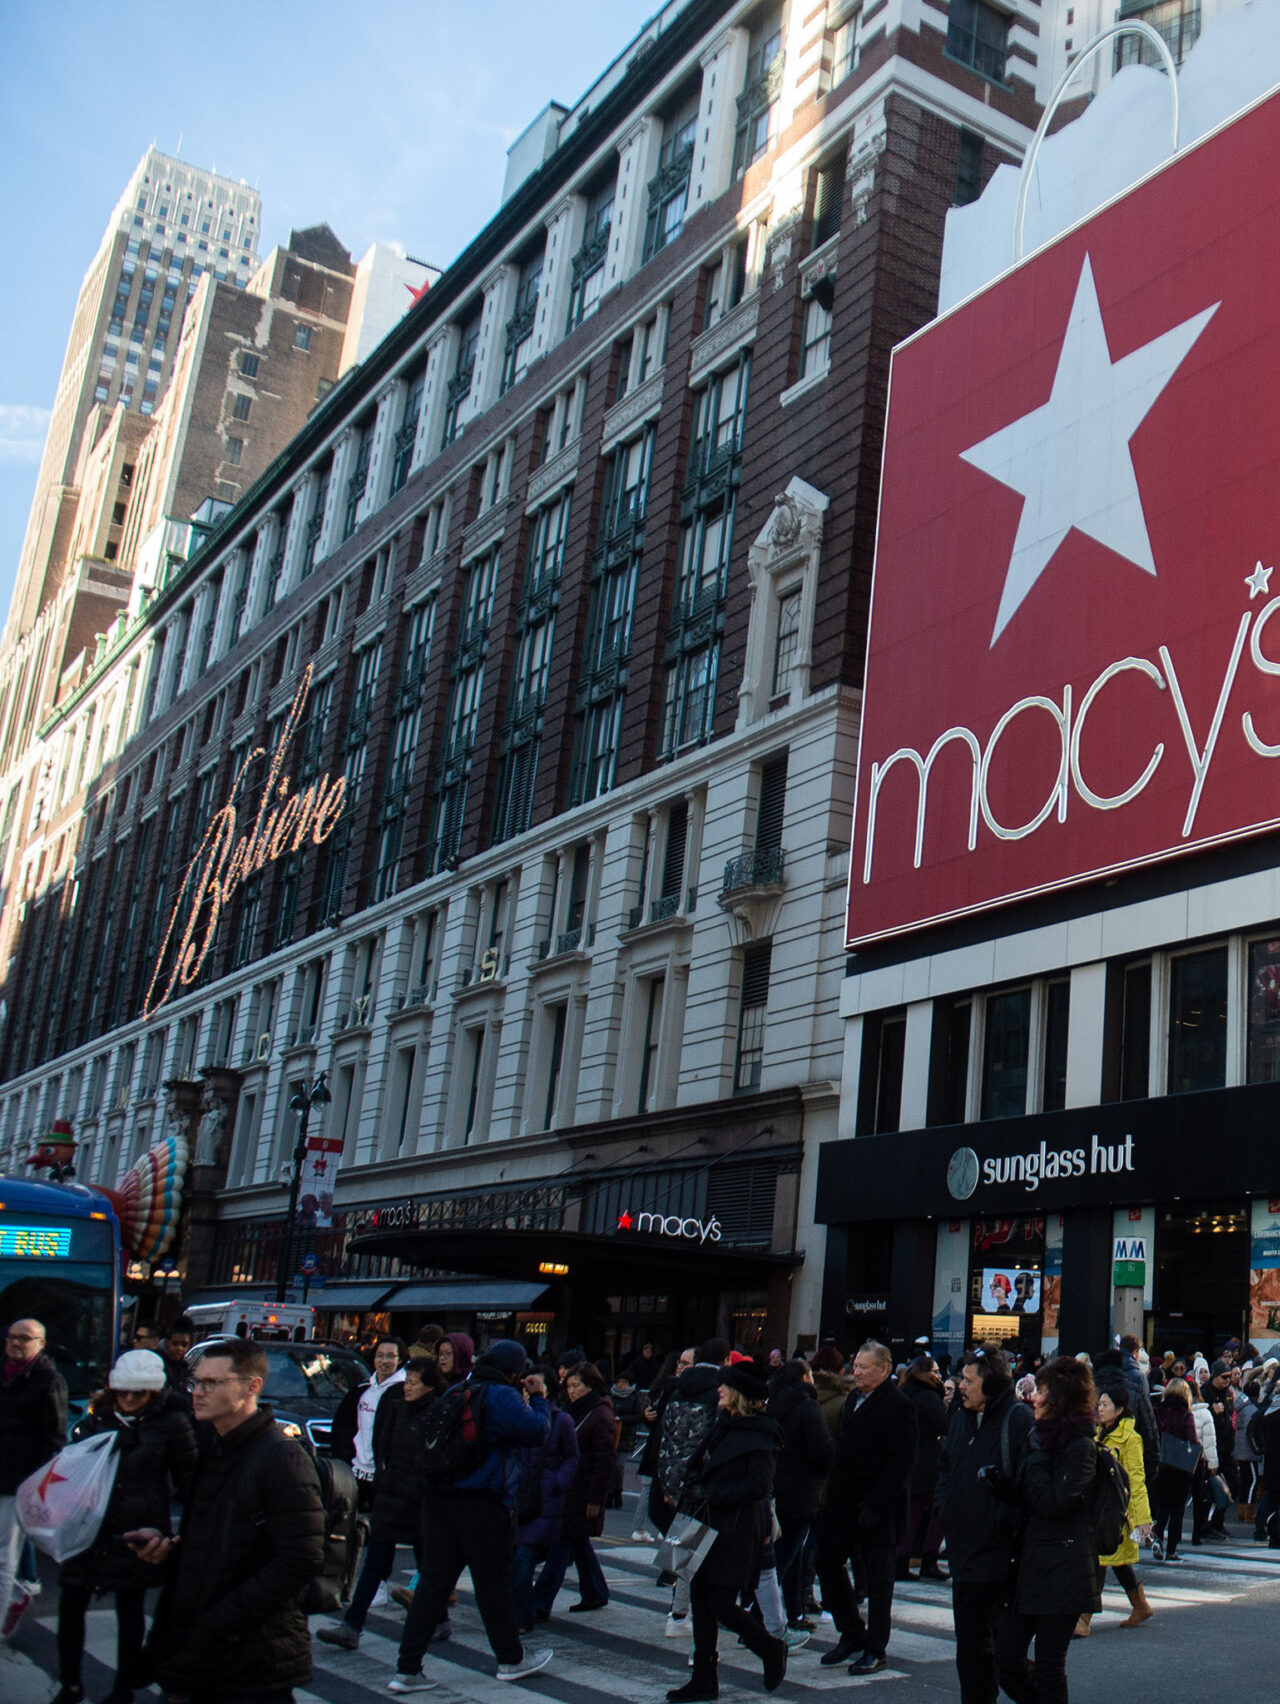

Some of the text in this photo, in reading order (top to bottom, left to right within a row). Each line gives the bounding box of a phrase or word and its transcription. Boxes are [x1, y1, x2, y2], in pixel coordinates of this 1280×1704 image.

[143, 662, 346, 1021] Believe
[983, 1134, 1135, 1192] sunglass hut
[14, 1231, 59, 1256] BUS
[638, 1212, 721, 1245] macy's
[525, 1322, 547, 1333] GUCCI
